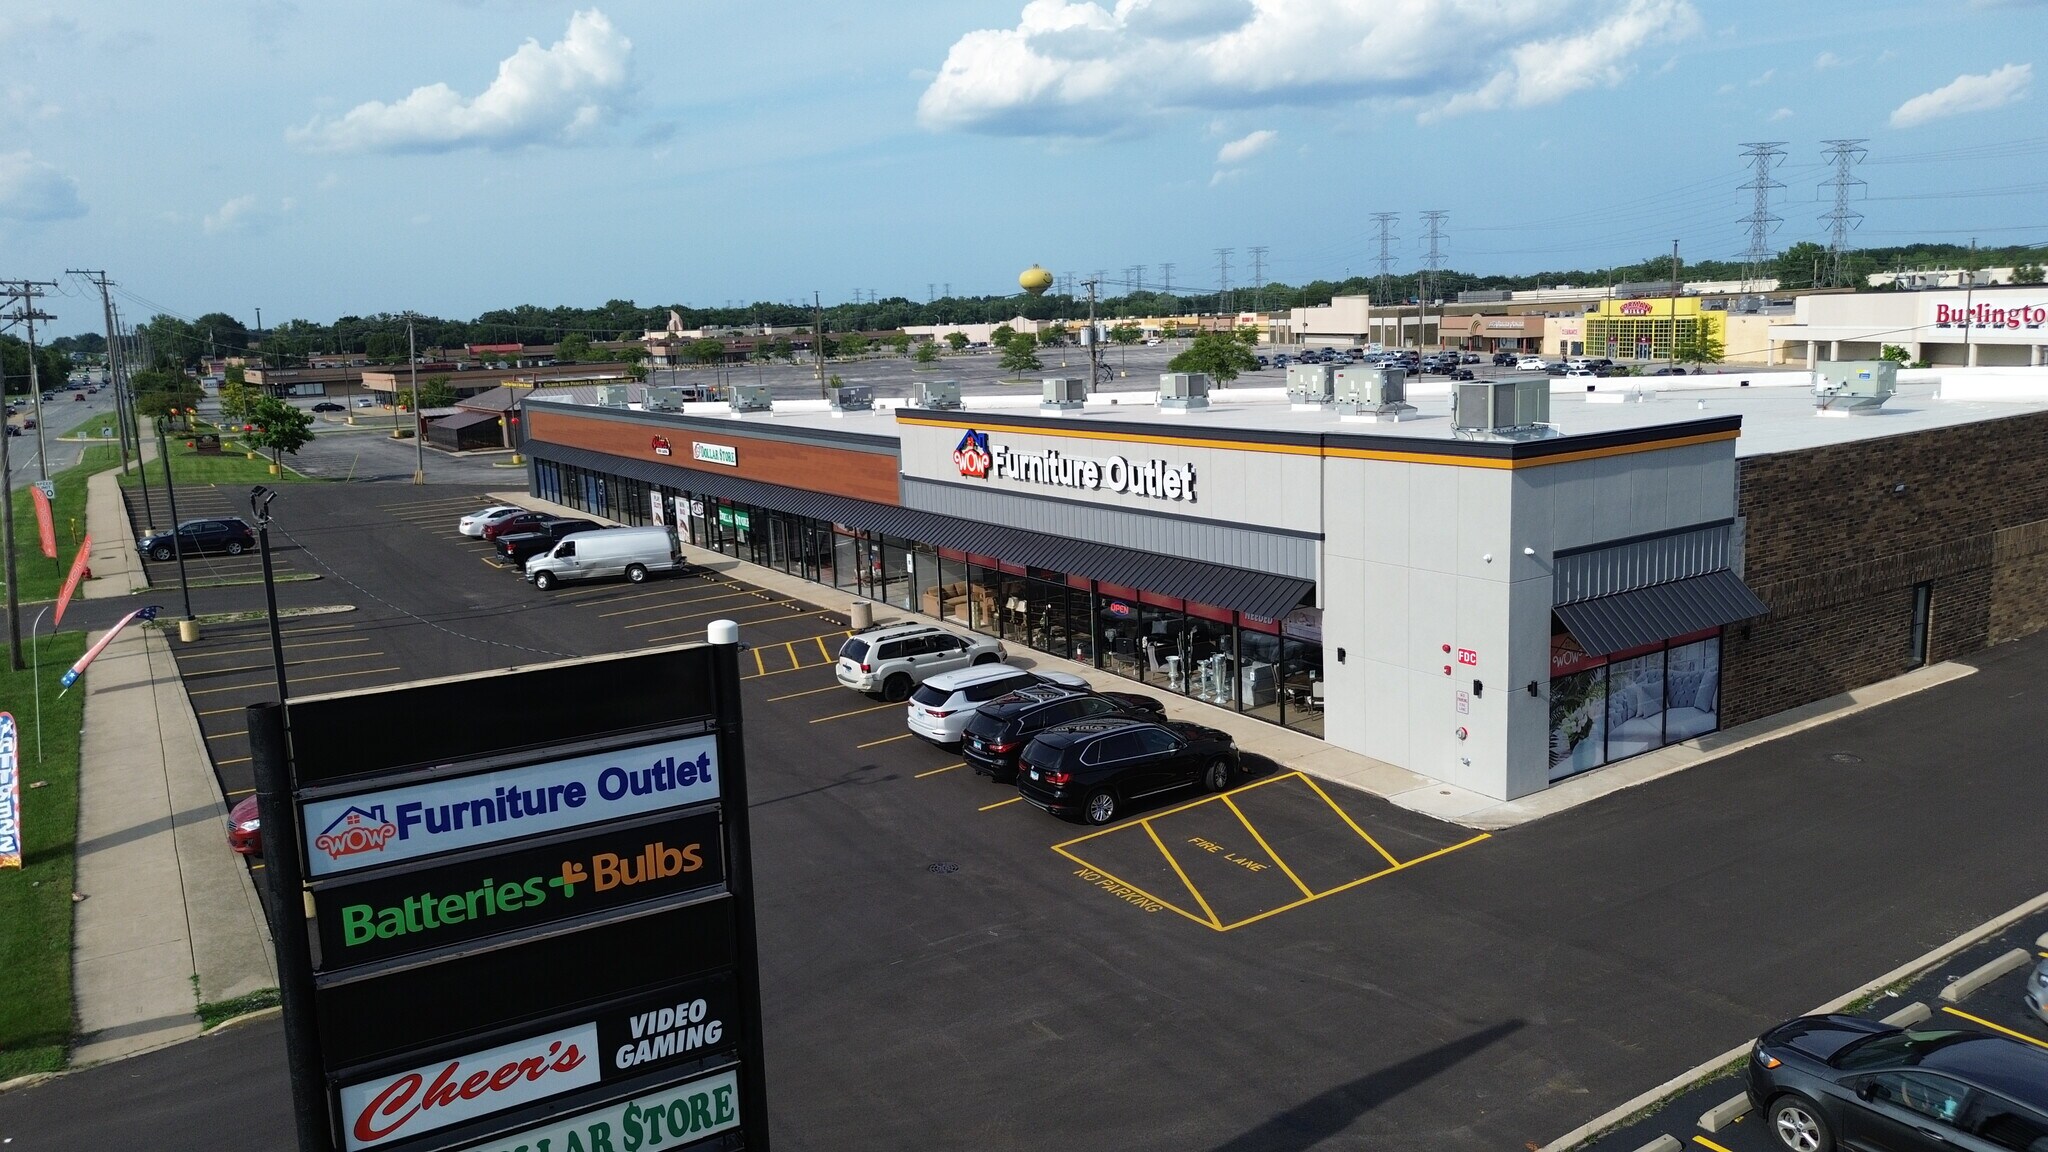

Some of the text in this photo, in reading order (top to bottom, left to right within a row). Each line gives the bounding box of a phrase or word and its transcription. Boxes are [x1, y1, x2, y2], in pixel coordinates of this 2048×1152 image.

[1936, 303, 2048, 329] Burlingto
[992, 445, 1099, 488] Furniture
[1105, 455, 1195, 500] Outlet
[1110, 603, 1130, 615] OPEN
[1458, 651, 1476, 663] FDC
[317, 751, 712, 854] WOW Furniture Outlet
[1187, 837, 1267, 872] FIRE LANE
[342, 876, 546, 947] Batteries
[592, 842, 703, 892] Bulbs
[1073, 868, 1164, 913] NO PARKING
[630, 998, 707, 1039] VIDEO
[615, 1020, 723, 1069] GAMING
[353, 1040, 587, 1142] Cheer's
